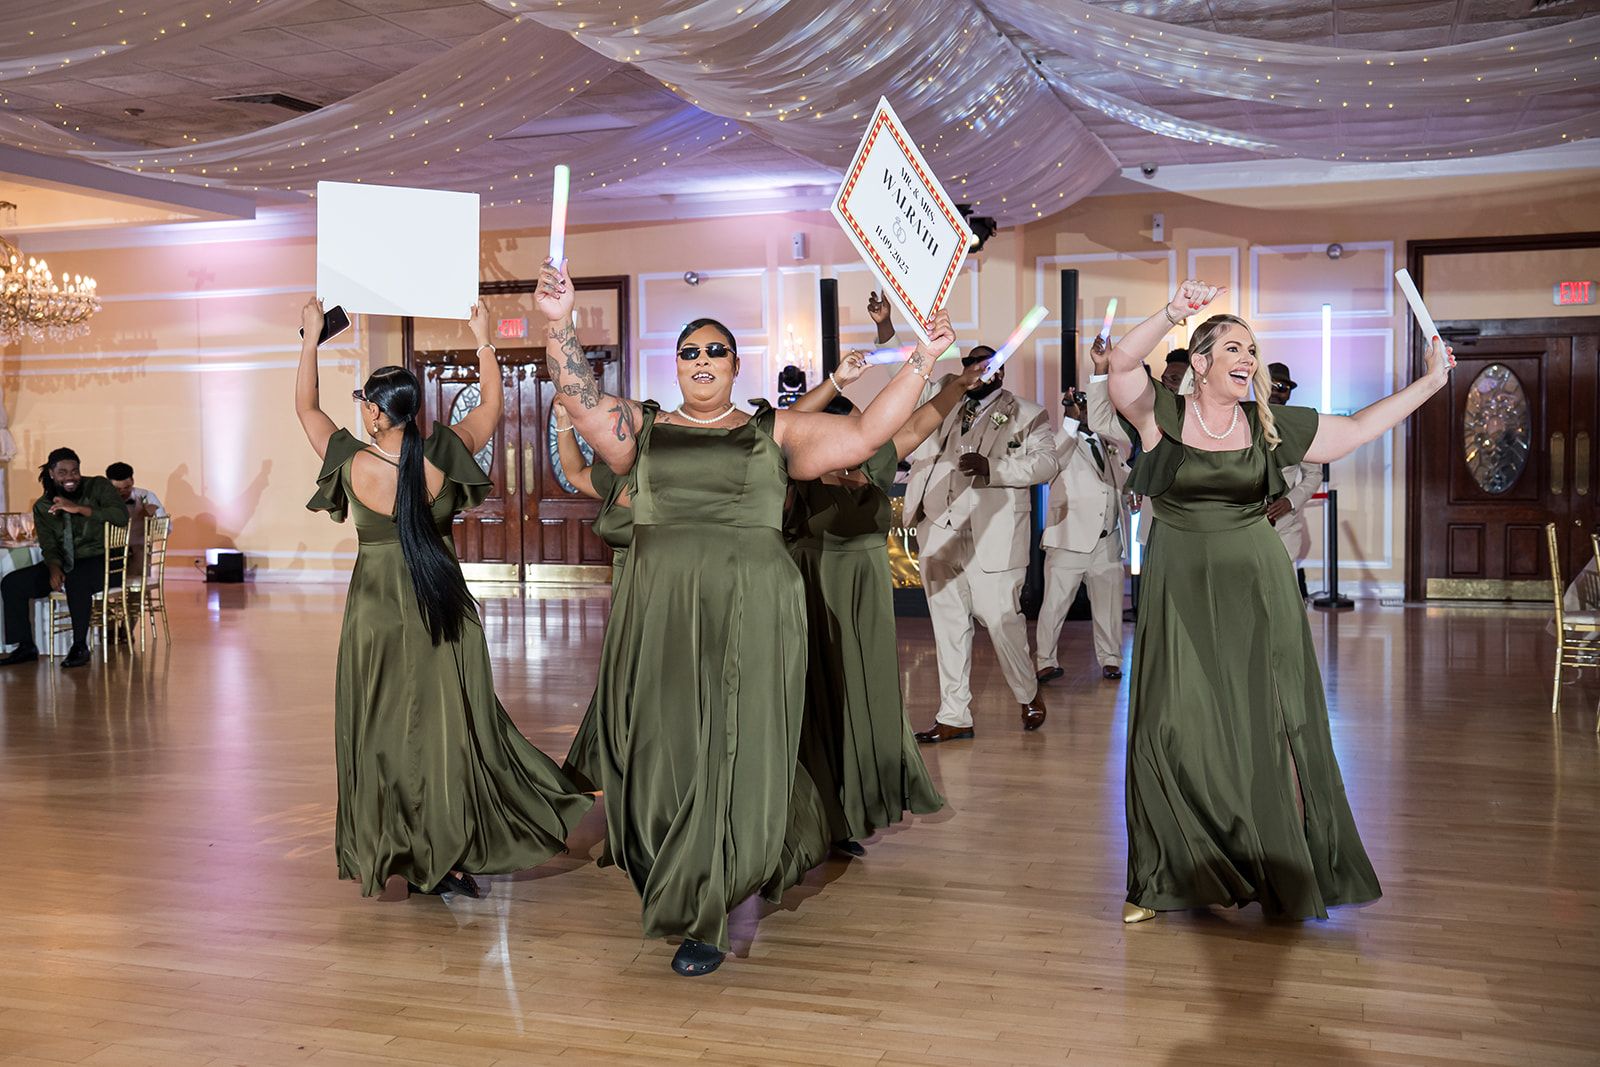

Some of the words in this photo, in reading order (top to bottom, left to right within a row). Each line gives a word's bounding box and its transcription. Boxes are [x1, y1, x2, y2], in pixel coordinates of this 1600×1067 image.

[883, 168, 939, 257] WALRATH
[901, 167, 912, 190] MR.
[913, 188, 920, 199] &
[920, 197, 936, 225] MRS.
[875, 225, 910, 275] 11.09.2025
[1560, 281, 1591, 304] EXIT
[501, 319, 523, 337] EXIT
